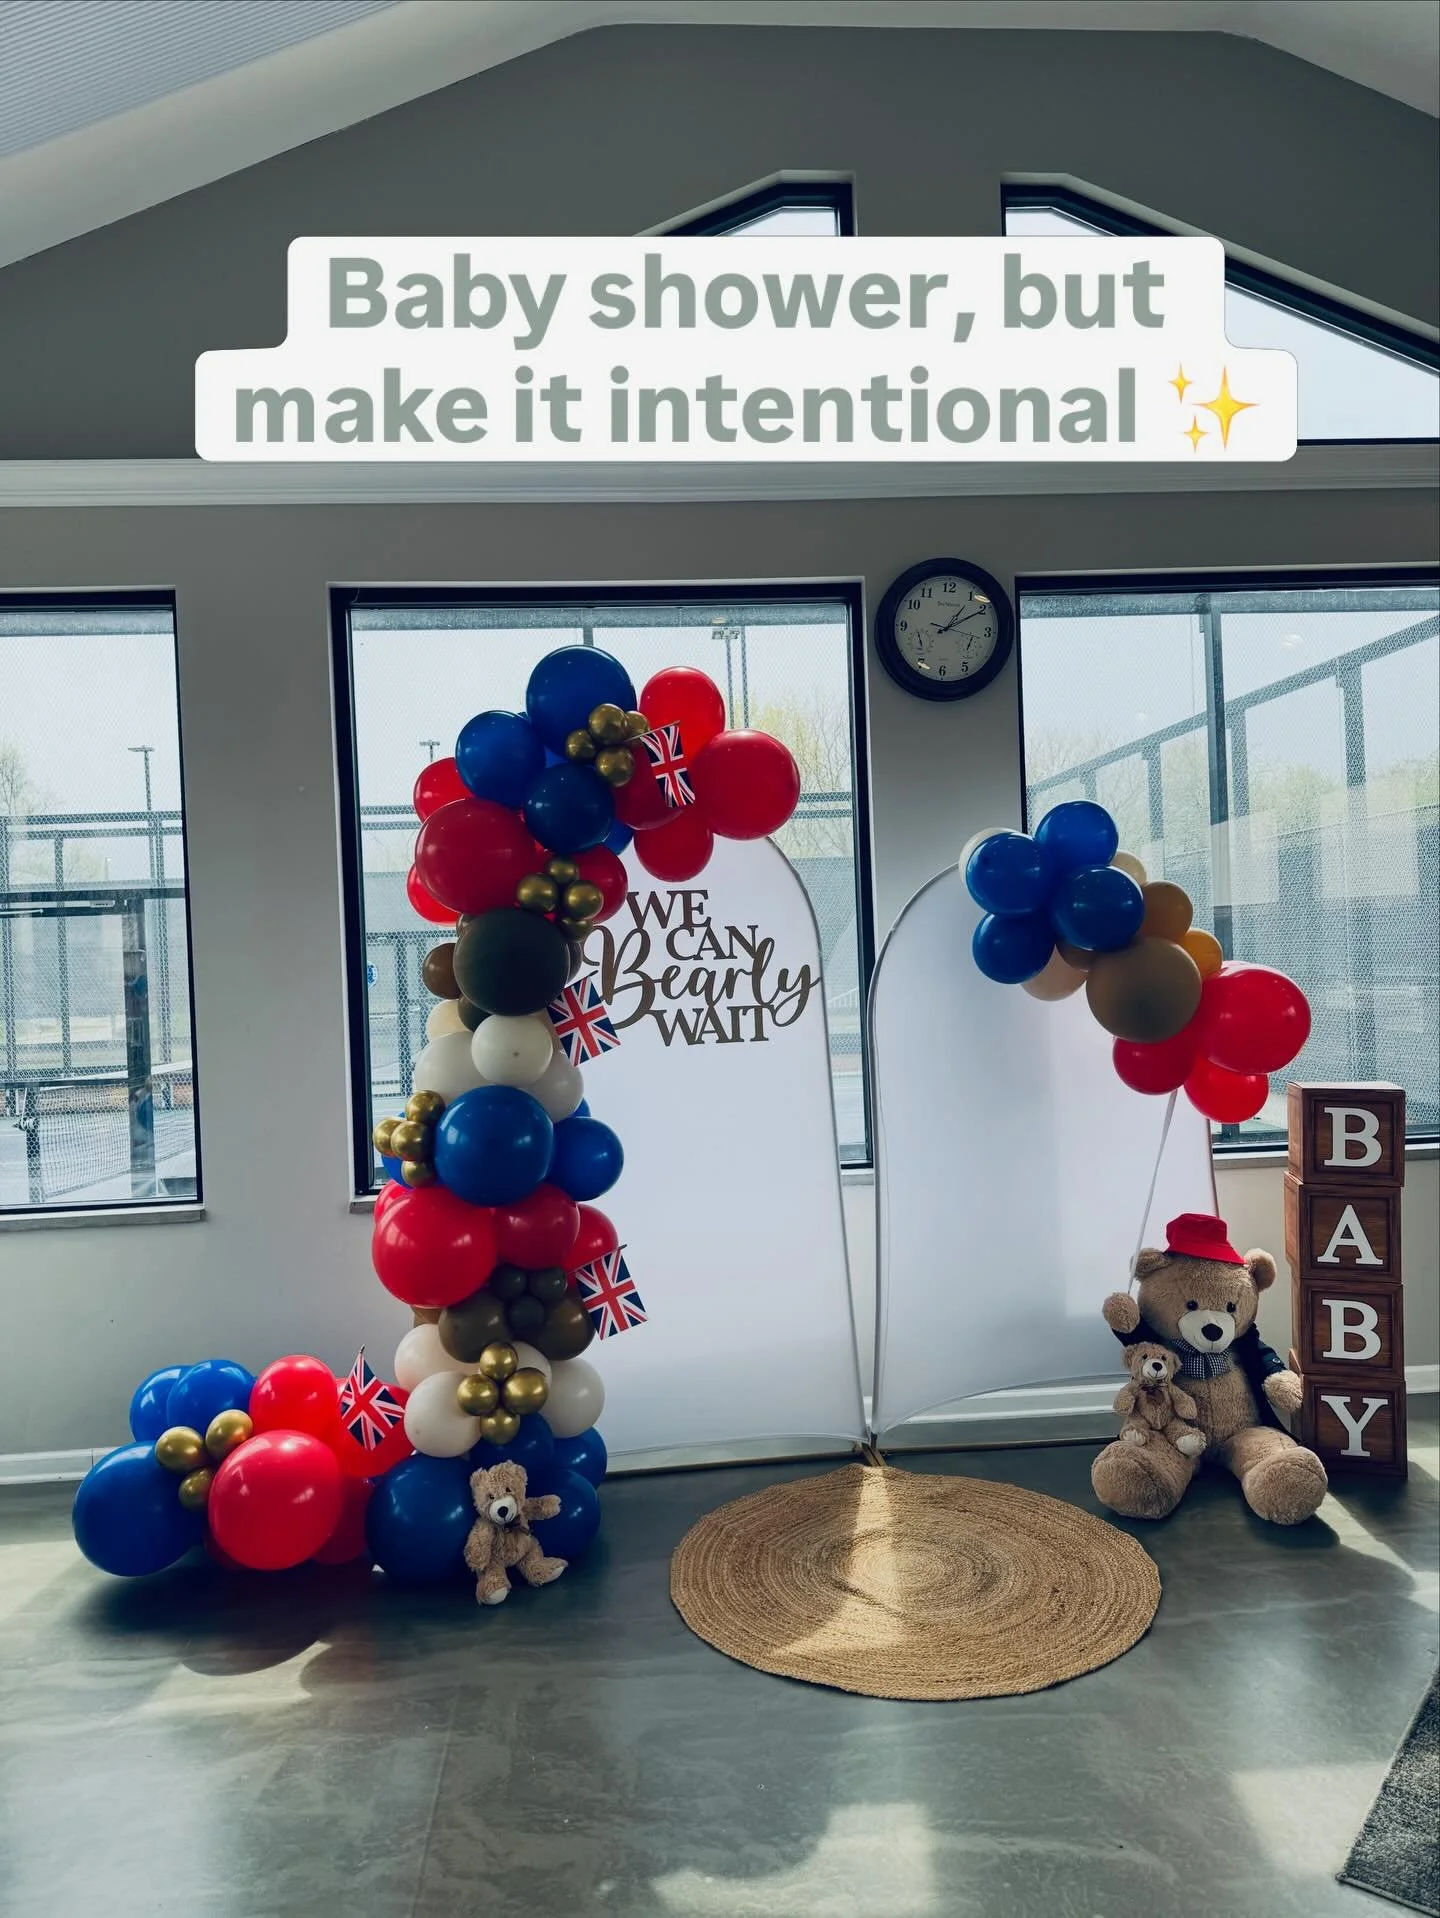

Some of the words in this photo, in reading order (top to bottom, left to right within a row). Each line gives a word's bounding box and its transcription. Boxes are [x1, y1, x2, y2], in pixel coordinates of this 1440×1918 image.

[920, 587, 932, 598] 11
[943, 582, 957, 593] 12
[968, 591, 974, 602] 1
[908, 599, 921, 610] 10
[979, 604, 986, 615] 2
[900, 620, 908, 632] 9
[984, 627, 992, 638] 3
[939, 665, 946, 677] 6
[961, 661, 969, 672] 5
[626, 889, 712, 929] WE
[665, 924, 759, 961] CAN
[582, 925, 822, 1030] Bearly
[646, 1004, 769, 1047] WAIT
[1316, 1106, 1389, 1457] BABY
